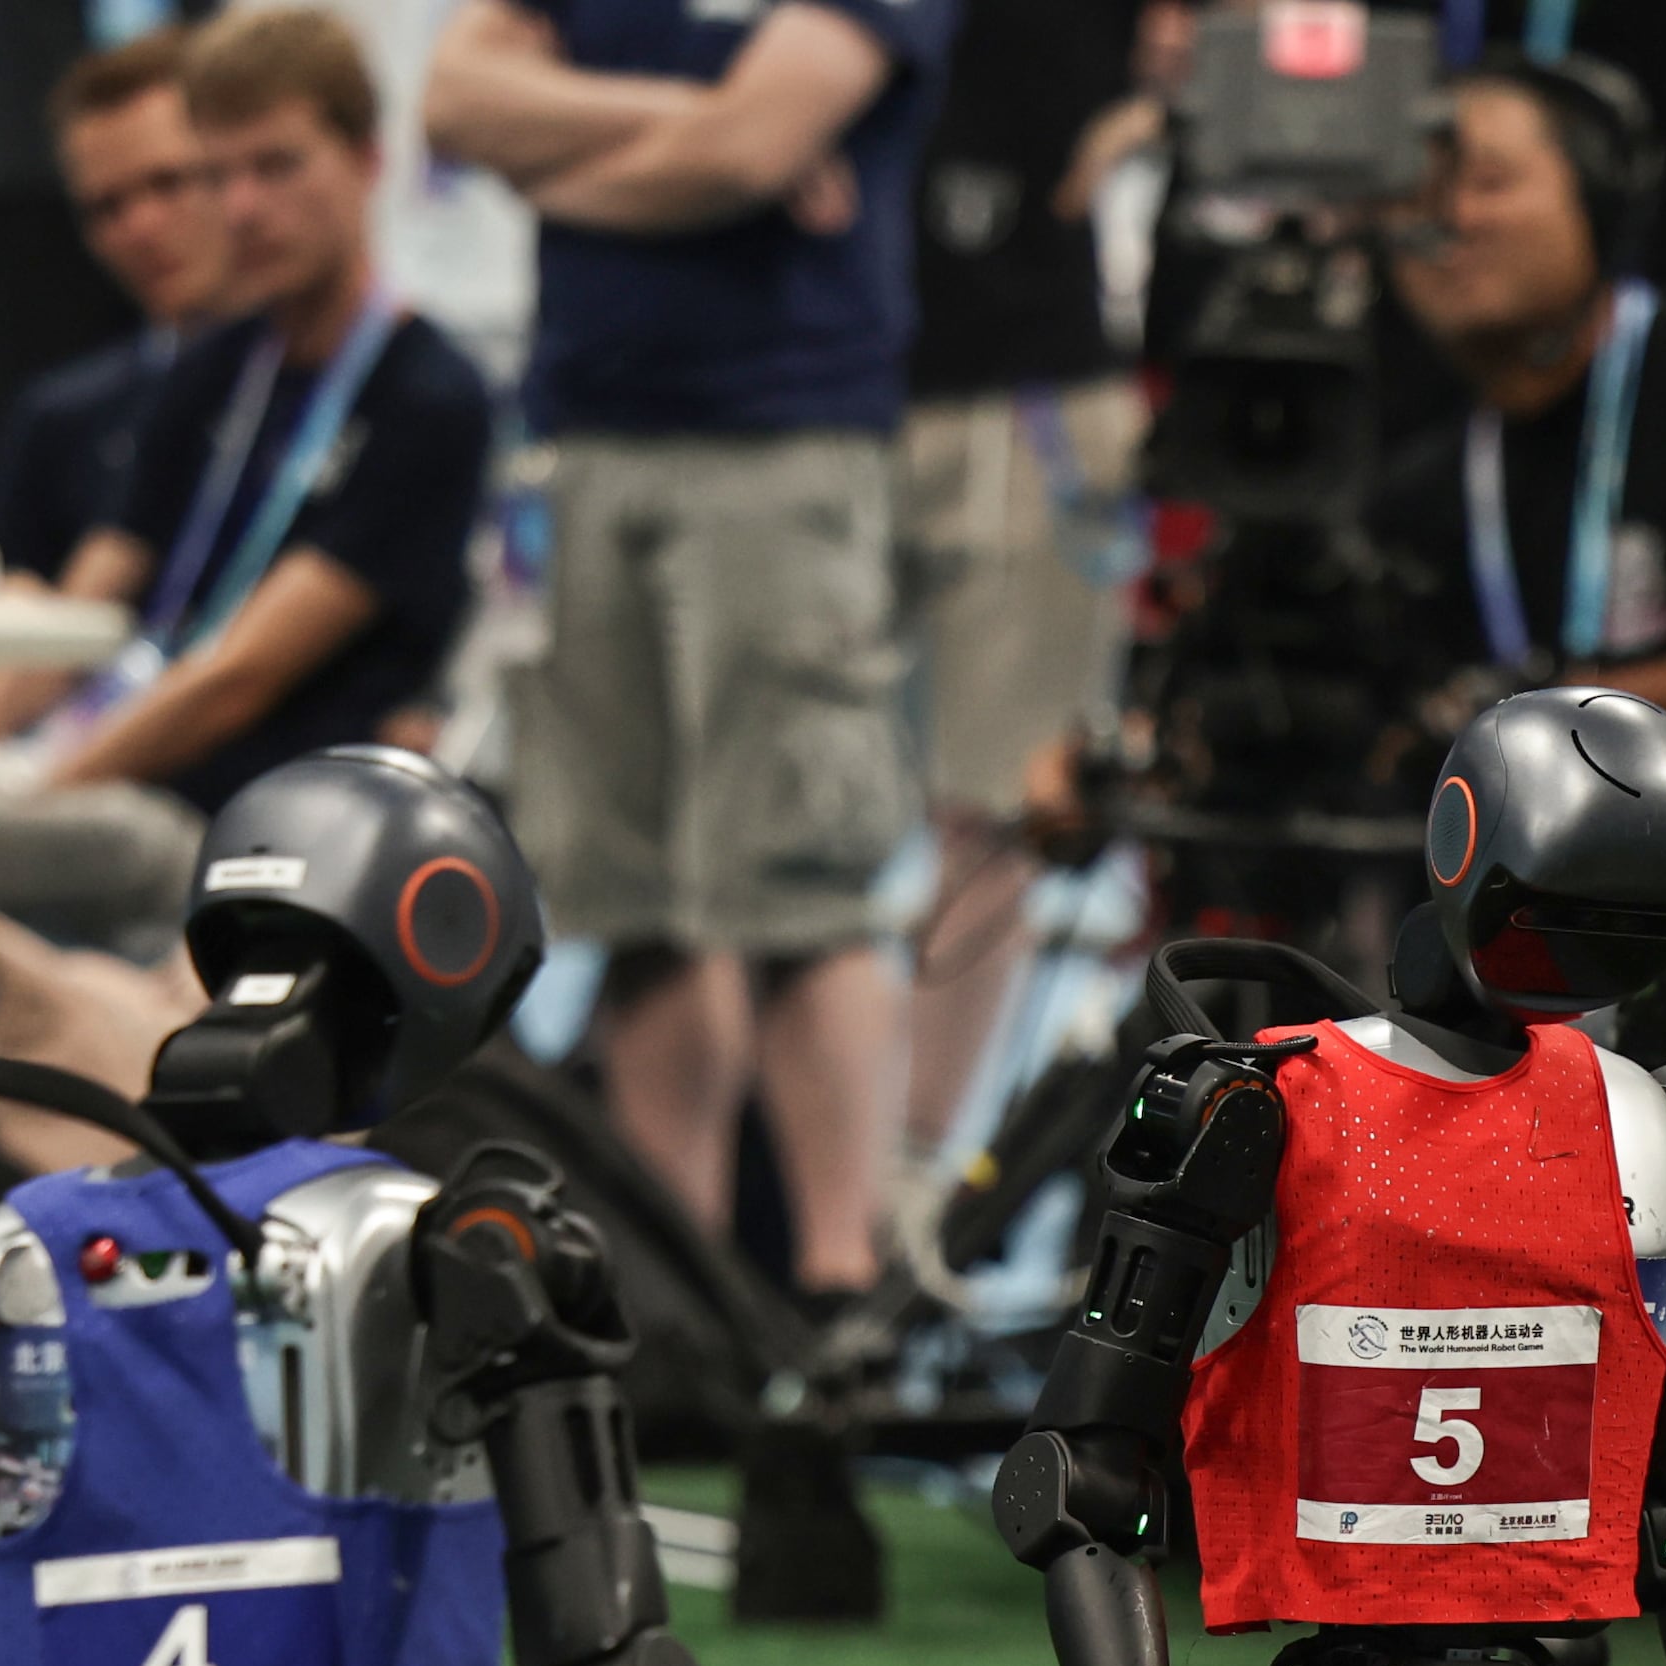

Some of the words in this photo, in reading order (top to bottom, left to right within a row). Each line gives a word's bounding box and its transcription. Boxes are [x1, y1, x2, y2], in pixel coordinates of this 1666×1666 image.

[1399, 1323, 1544, 1341] 世界人形机器人运动会
[1399, 1344, 1417, 1353] The
[1419, 1344, 1445, 1353] World
[1446, 1344, 1489, 1352] Humanoid
[1491, 1343, 1516, 1352] Robot
[1517, 1342, 1544, 1351] Games
[1410, 1387, 1485, 1486] 5
